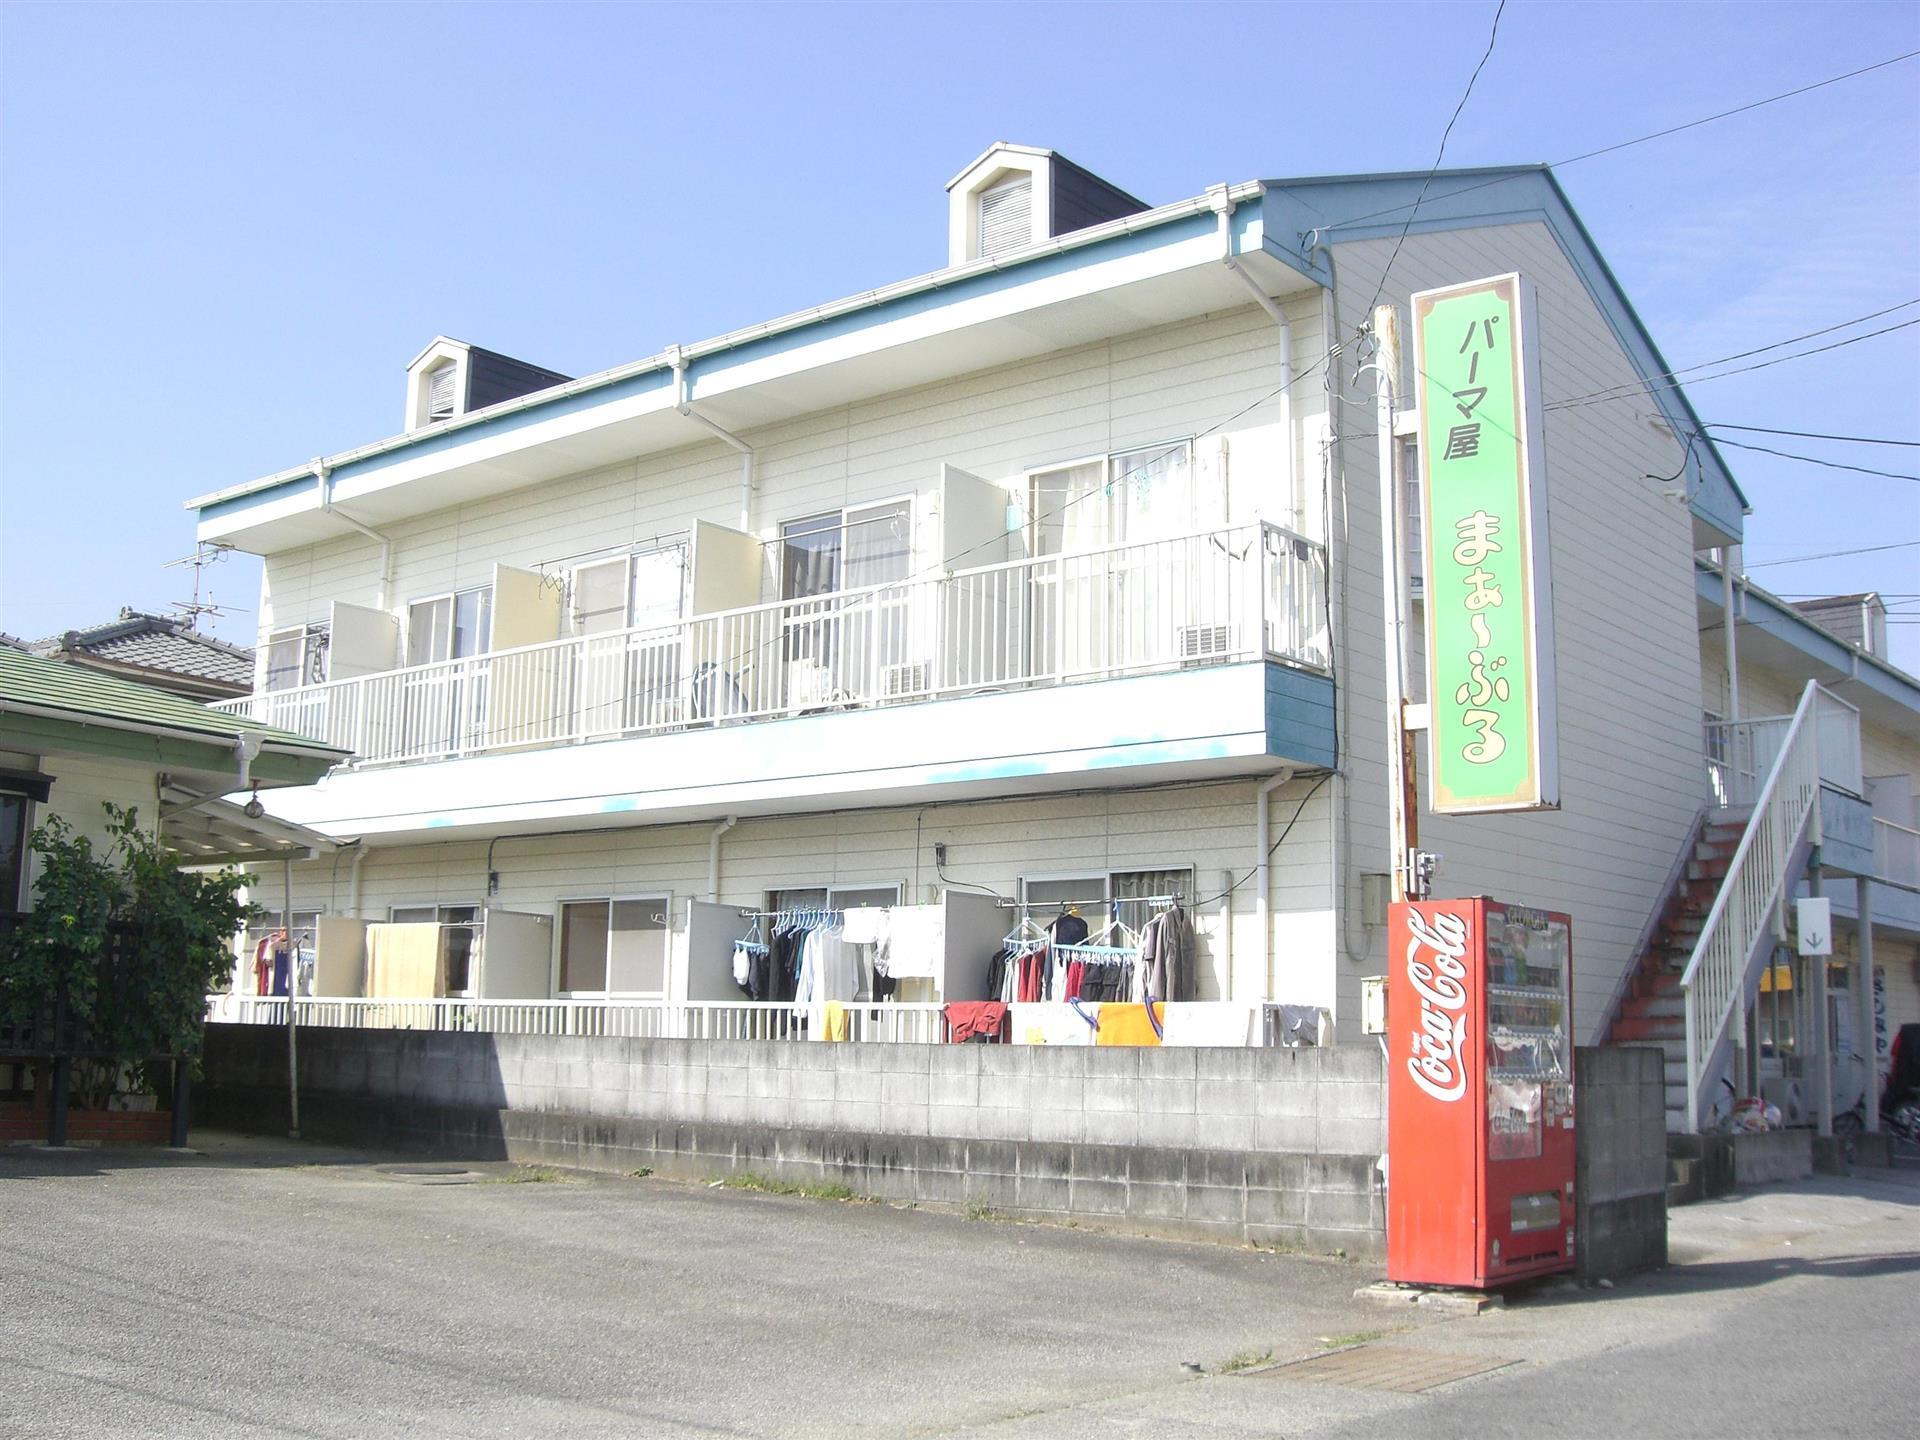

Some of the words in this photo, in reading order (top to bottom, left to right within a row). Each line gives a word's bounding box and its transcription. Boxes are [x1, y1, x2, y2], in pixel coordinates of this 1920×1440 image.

[1443, 315, 1500, 461] パーマ屋
[1407, 906, 1467, 1102] Coca-Cola
